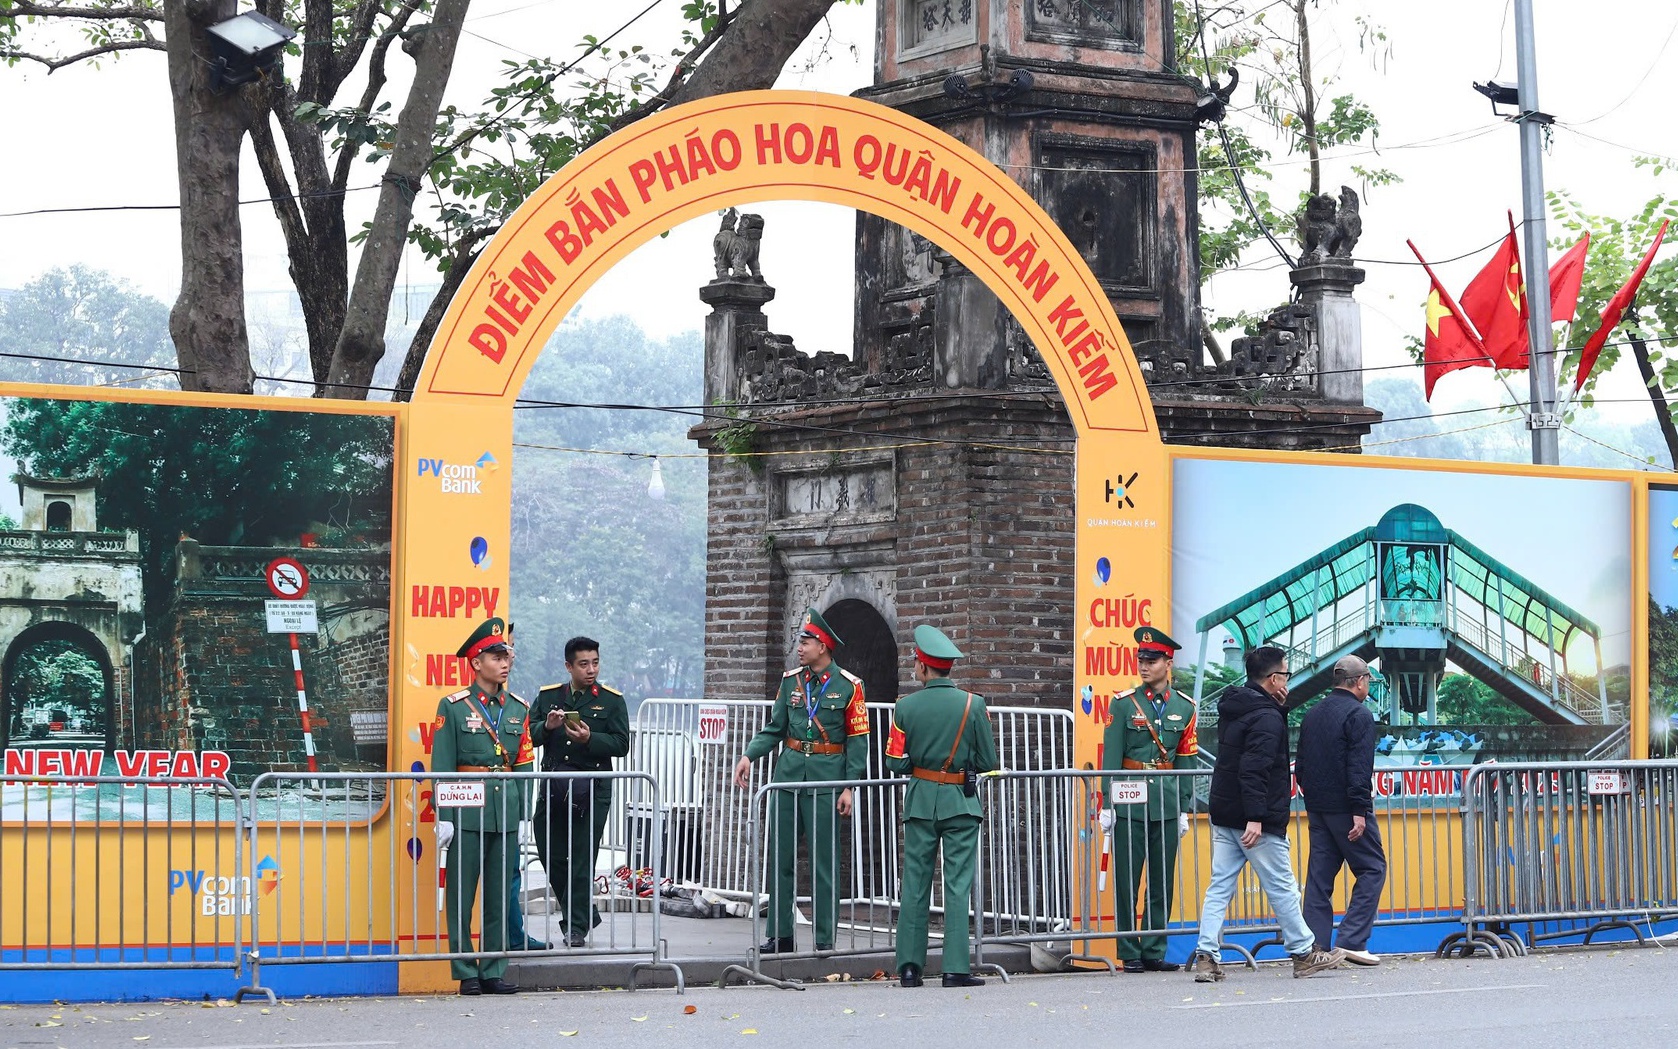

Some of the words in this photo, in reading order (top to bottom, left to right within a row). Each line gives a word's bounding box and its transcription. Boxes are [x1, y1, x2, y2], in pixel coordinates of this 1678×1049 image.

[467, 250, 557, 365] ĐIỂM
[543, 186, 632, 267] BẮN
[628, 127, 742, 205] PHÁO
[754, 122, 842, 168] HOA
[853, 133, 961, 214] QUẬN
[960, 191, 1060, 304] HOÀN
[1046, 294, 1119, 401] KIẾM
[417, 457, 476, 479] PVcom
[441, 477, 482, 494] Bank
[411, 585, 500, 619] HAPPY
[1090, 593, 1152, 628] CHÚC
[1085, 641, 1138, 676] MỪN
[700, 717, 725, 740] STOP
[5, 749, 103, 788] NEW
[114, 749, 231, 788] YEAR
[1119, 791, 1141, 799] STOP
[1595, 782, 1614, 790] STOP
